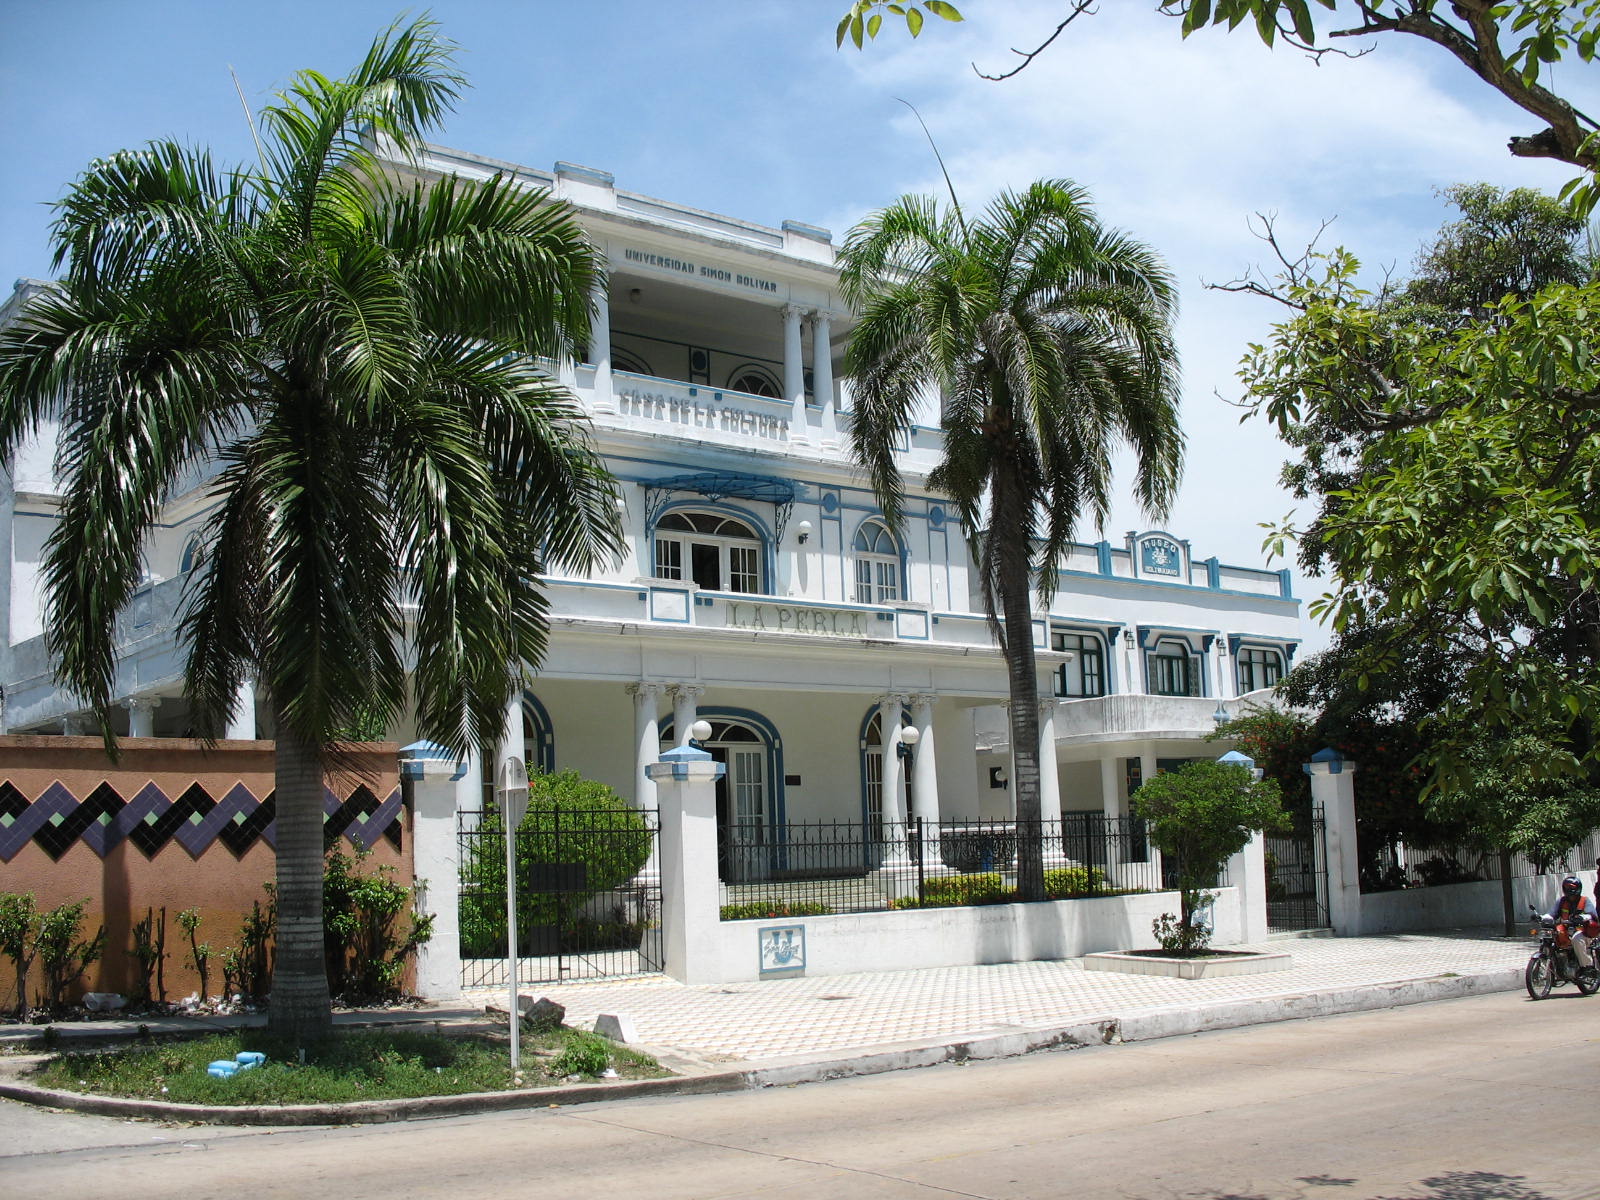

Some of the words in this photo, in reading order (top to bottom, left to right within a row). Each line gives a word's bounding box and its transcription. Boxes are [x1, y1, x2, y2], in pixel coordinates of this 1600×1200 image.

[625, 248, 695, 274] UNIVERSIDAD
[699, 266, 732, 283] SIMON
[736, 274, 777, 293] BOLIVAR
[619, 389, 666, 409] CASA
[669, 396, 691, 414] DE
[694, 400, 717, 418] LA
[721, 406, 789, 431] CULTURA
[1143, 539, 1177, 553] MUSEO
[728, 601, 767, 631] LA
[776, 605, 865, 638] PERLA
